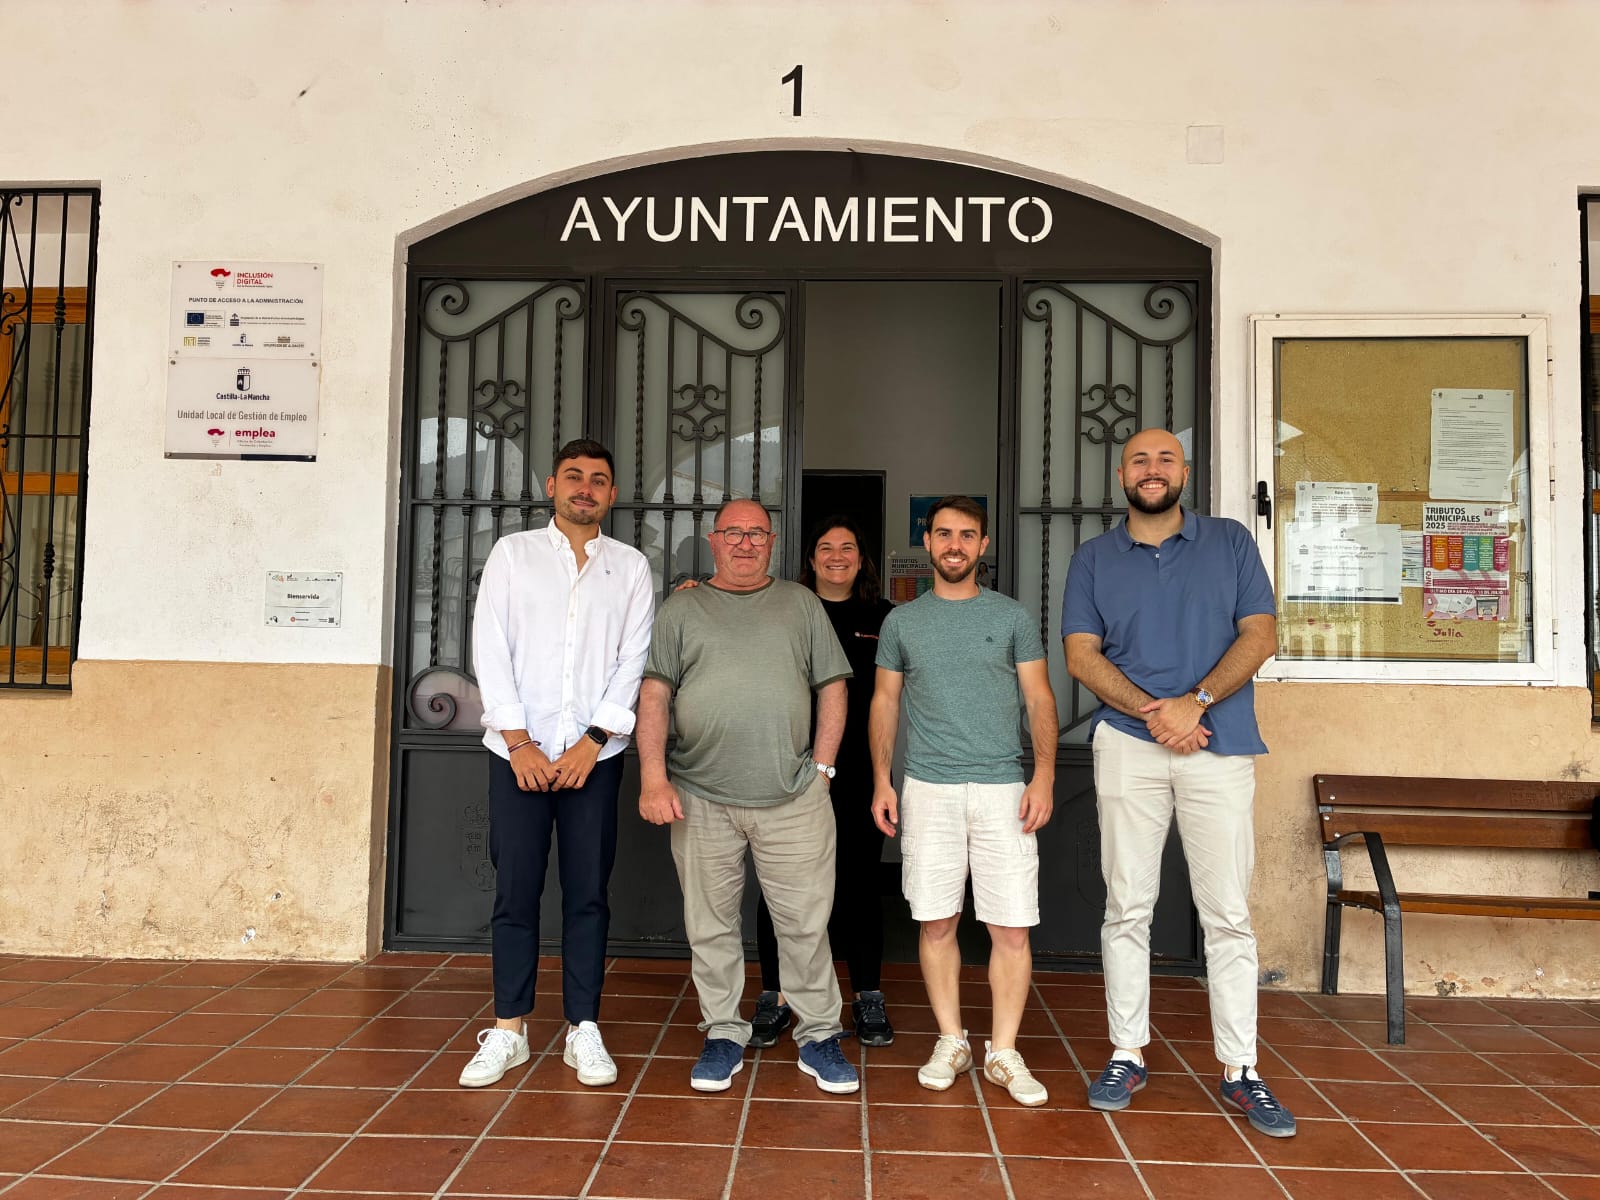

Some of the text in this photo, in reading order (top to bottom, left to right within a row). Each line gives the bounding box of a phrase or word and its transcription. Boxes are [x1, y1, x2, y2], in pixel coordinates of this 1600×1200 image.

[780, 65, 804, 117] 1
[559, 195, 1054, 244] AYUNTAMIENTO
[248, 393, 271, 401] Mancha
[177, 409, 308, 423] Unidad Local de Gestión de Empleo
[235, 426, 276, 440] emplea
[1425, 506, 1466, 515] TRIBUTOS
[1425, 514, 1481, 523] MUNICIPALES
[1425, 521, 1446, 530] 2025
[1433, 627, 1464, 638] Julia
